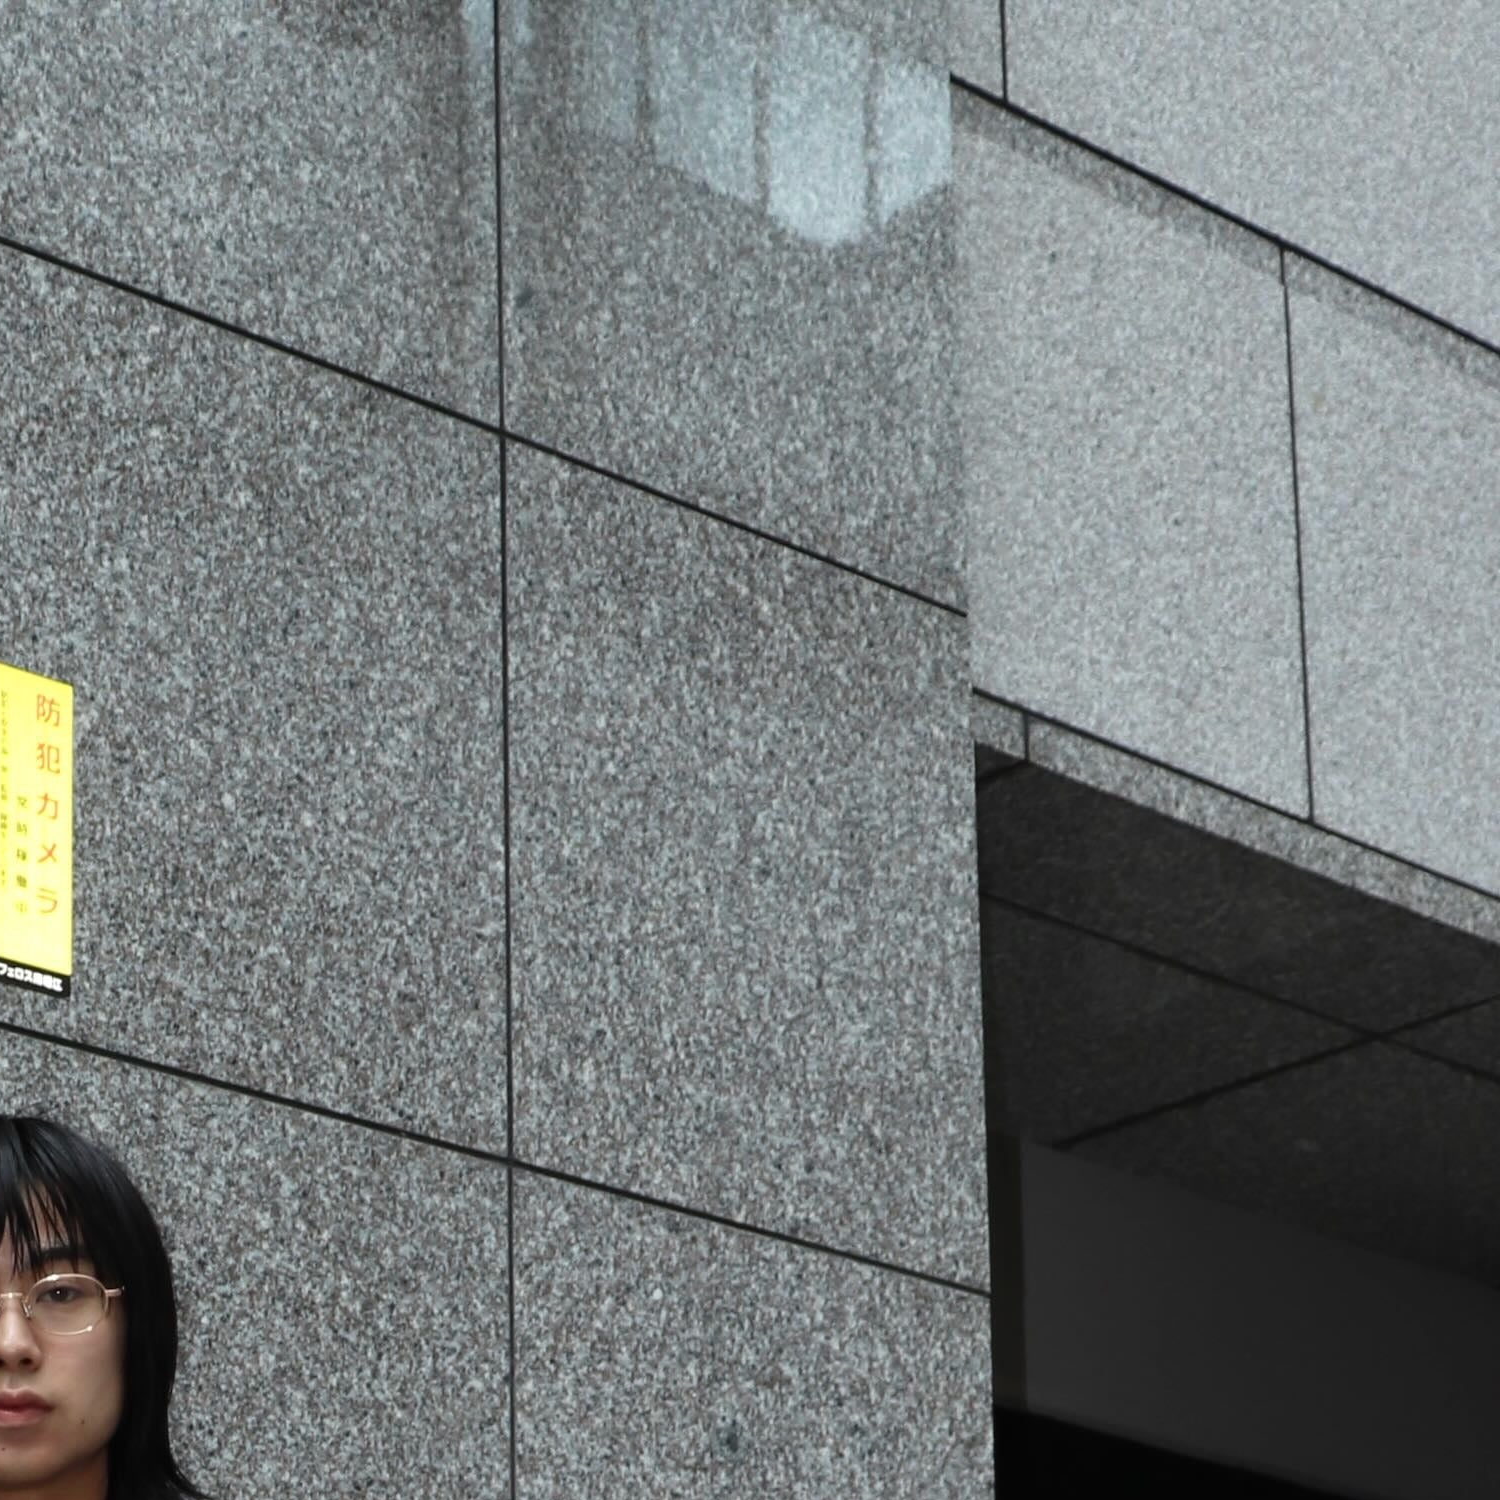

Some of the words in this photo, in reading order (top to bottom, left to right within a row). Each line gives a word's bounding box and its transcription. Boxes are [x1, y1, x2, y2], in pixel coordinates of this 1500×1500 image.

[36, 694, 61, 915] 防犯カメラ
